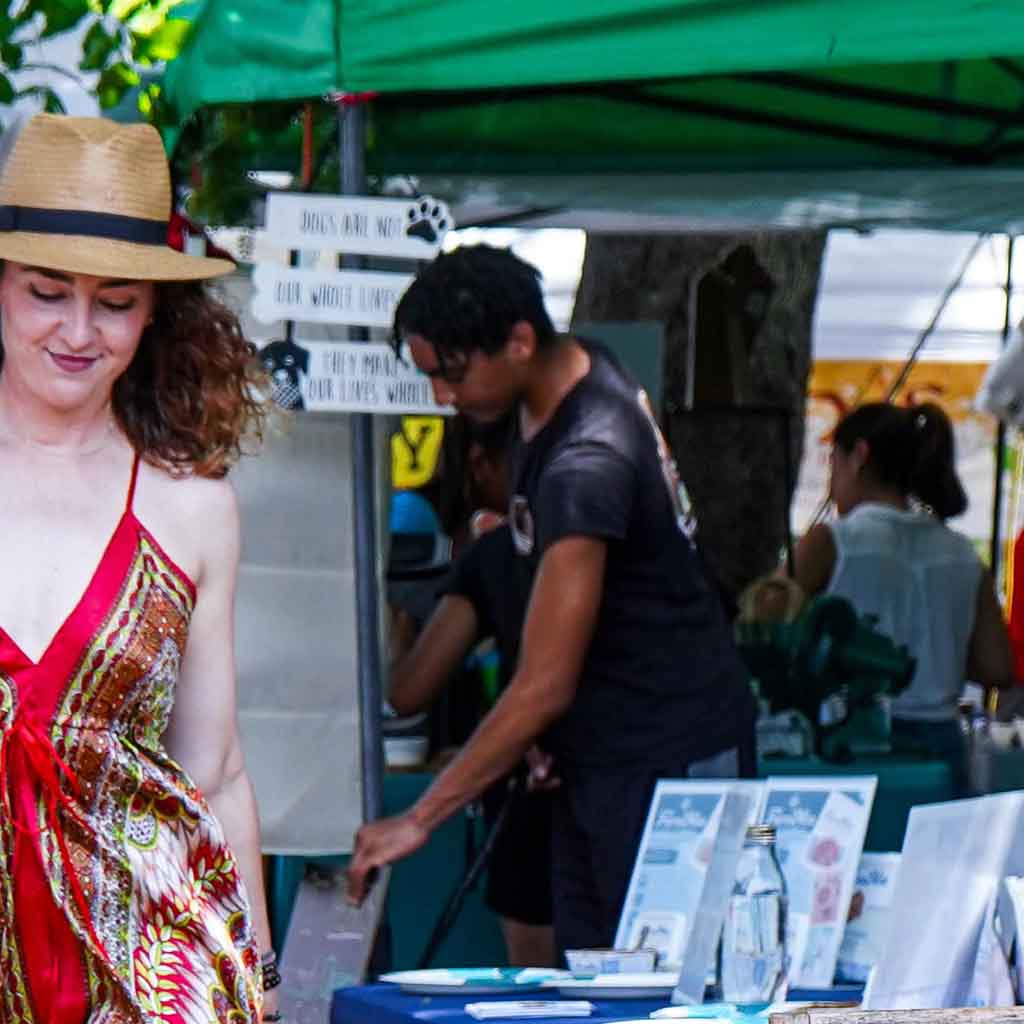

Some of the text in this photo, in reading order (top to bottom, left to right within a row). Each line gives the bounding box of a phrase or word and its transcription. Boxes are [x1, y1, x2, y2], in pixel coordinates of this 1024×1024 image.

[342, 213, 368, 238] ARE
[276, 280, 302, 305] OUR
[308, 379, 333, 401] OUR
